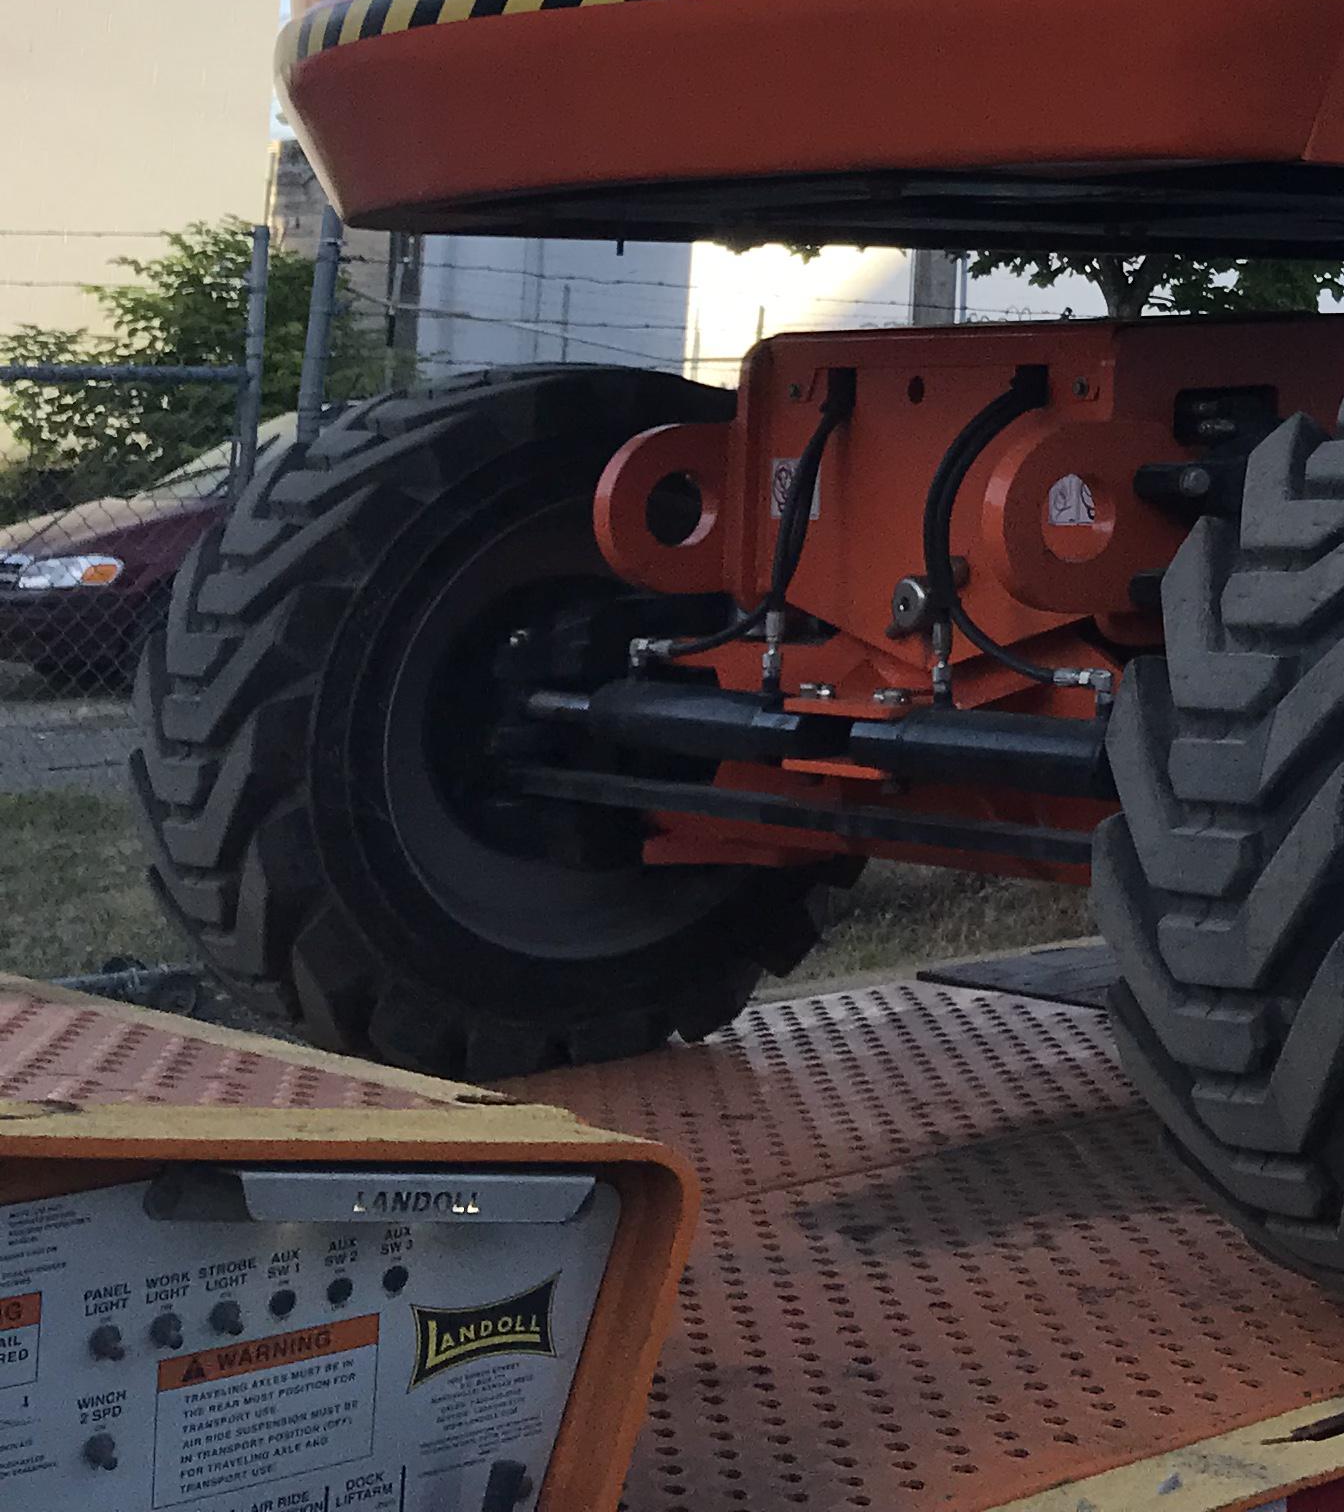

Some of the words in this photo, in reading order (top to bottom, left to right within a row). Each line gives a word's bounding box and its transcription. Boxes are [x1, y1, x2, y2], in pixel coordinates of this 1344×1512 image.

[353, 1191, 480, 1214] LANDOLL
[385, 1226, 412, 1241] AUX
[328, 1237, 358, 1253] AUX
[380, 1242, 402, 1256] SW
[271, 1249, 301, 1265] AUX
[325, 1253, 348, 1268] SW
[349, 1251, 358, 1262] 2
[198, 1257, 257, 1280] STROBE
[267, 1265, 290, 1279] SW
[145, 1271, 191, 1289] WORK
[205, 1272, 249, 1292] LIGHT
[84, 1282, 131, 1301] PANEL
[146, 1285, 190, 1304] LIGHT
[85, 1298, 129, 1317] LIGHT
[216, 1330, 331, 1371] WARNING
[426, 1314, 541, 1369] LANDOLL
[77, 1389, 127, 1410] WINCH
[183, 1406, 205, 1419] THE
[208, 1399, 240, 1413] REAR
[278, 1379, 330, 1398] POSITION
[333, 1372, 357, 1385] FOR
[184, 1382, 249, 1405] TRAVELING
[251, 1374, 288, 1390] AXLES
[92, 1405, 122, 1422] SPD
[182, 1412, 250, 1434] TRANSPORT
[182, 1437, 202, 1450] AIR
[205, 1429, 232, 1444] RIDE
[236, 1413, 307, 1436] SUSPENSION
[197, 1437, 264, 1460] TRANSPORT
[179, 1466, 203, 1479] FOR
[208, 1450, 270, 1473] TRAVELING
[273, 1442, 302, 1457] AXLE
[345, 1471, 385, 1492] DOCK
[277, 1490, 310, 1509] RIDE
[335, 1483, 393, 1508] LIFTARM
